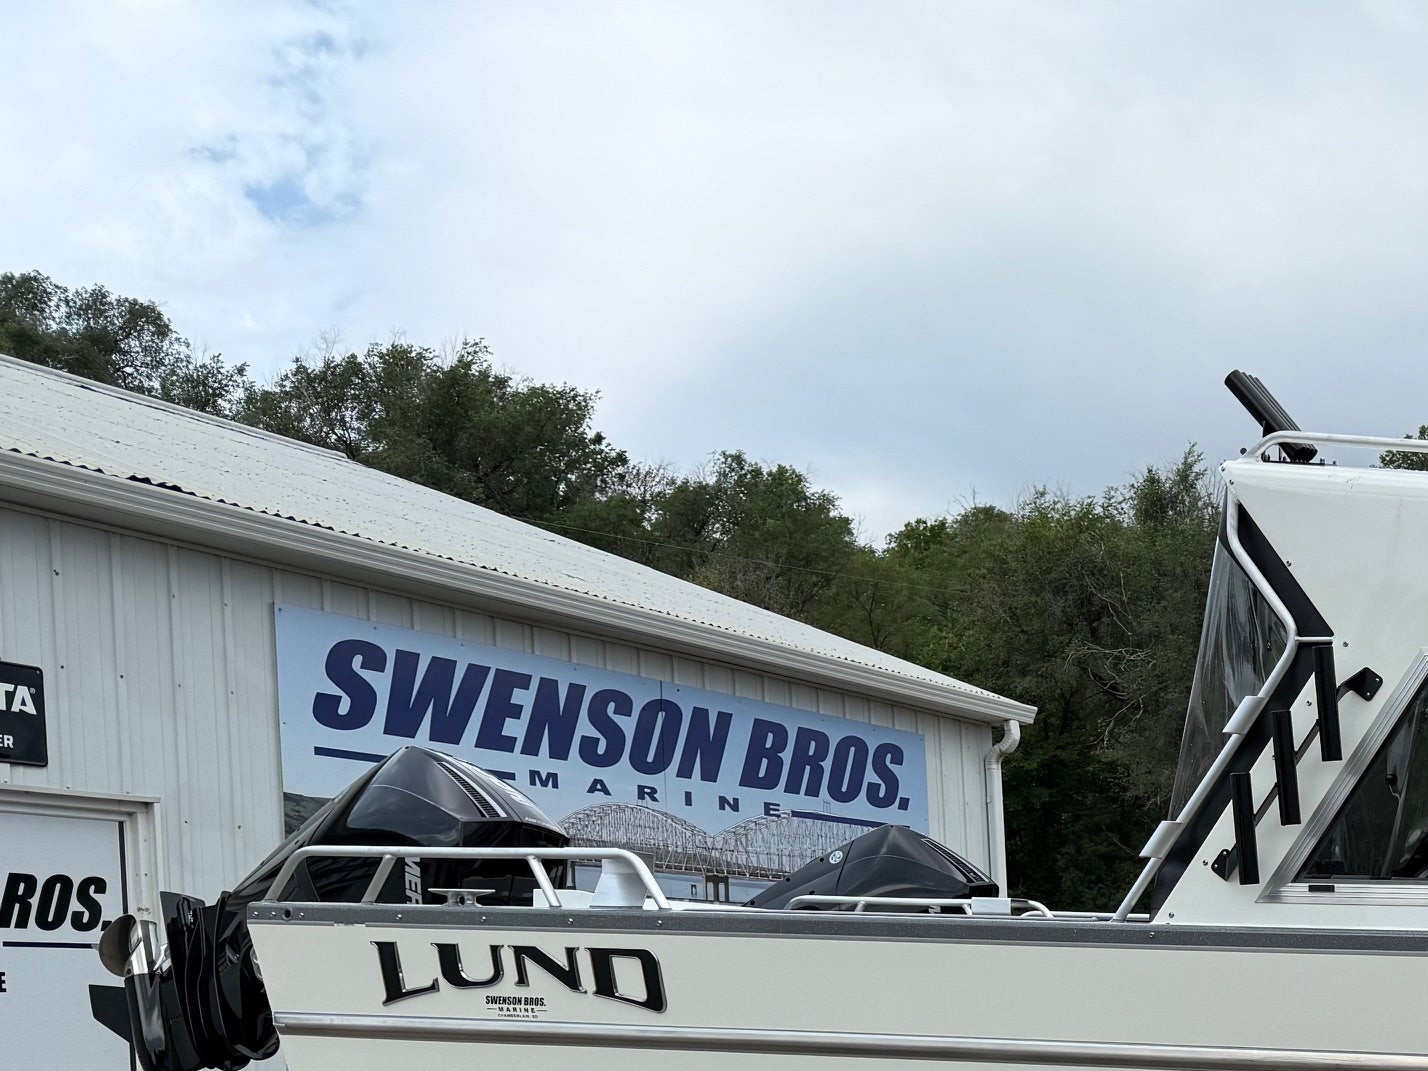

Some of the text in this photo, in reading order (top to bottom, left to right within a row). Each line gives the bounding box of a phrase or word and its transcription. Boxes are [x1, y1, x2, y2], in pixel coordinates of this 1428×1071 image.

[312, 639, 911, 811] SWENSON BROS.
[528, 769, 783, 818] MARINE
[370, 941, 668, 1014] LUND
[485, 995, 547, 1007] SWENSON BROS.
